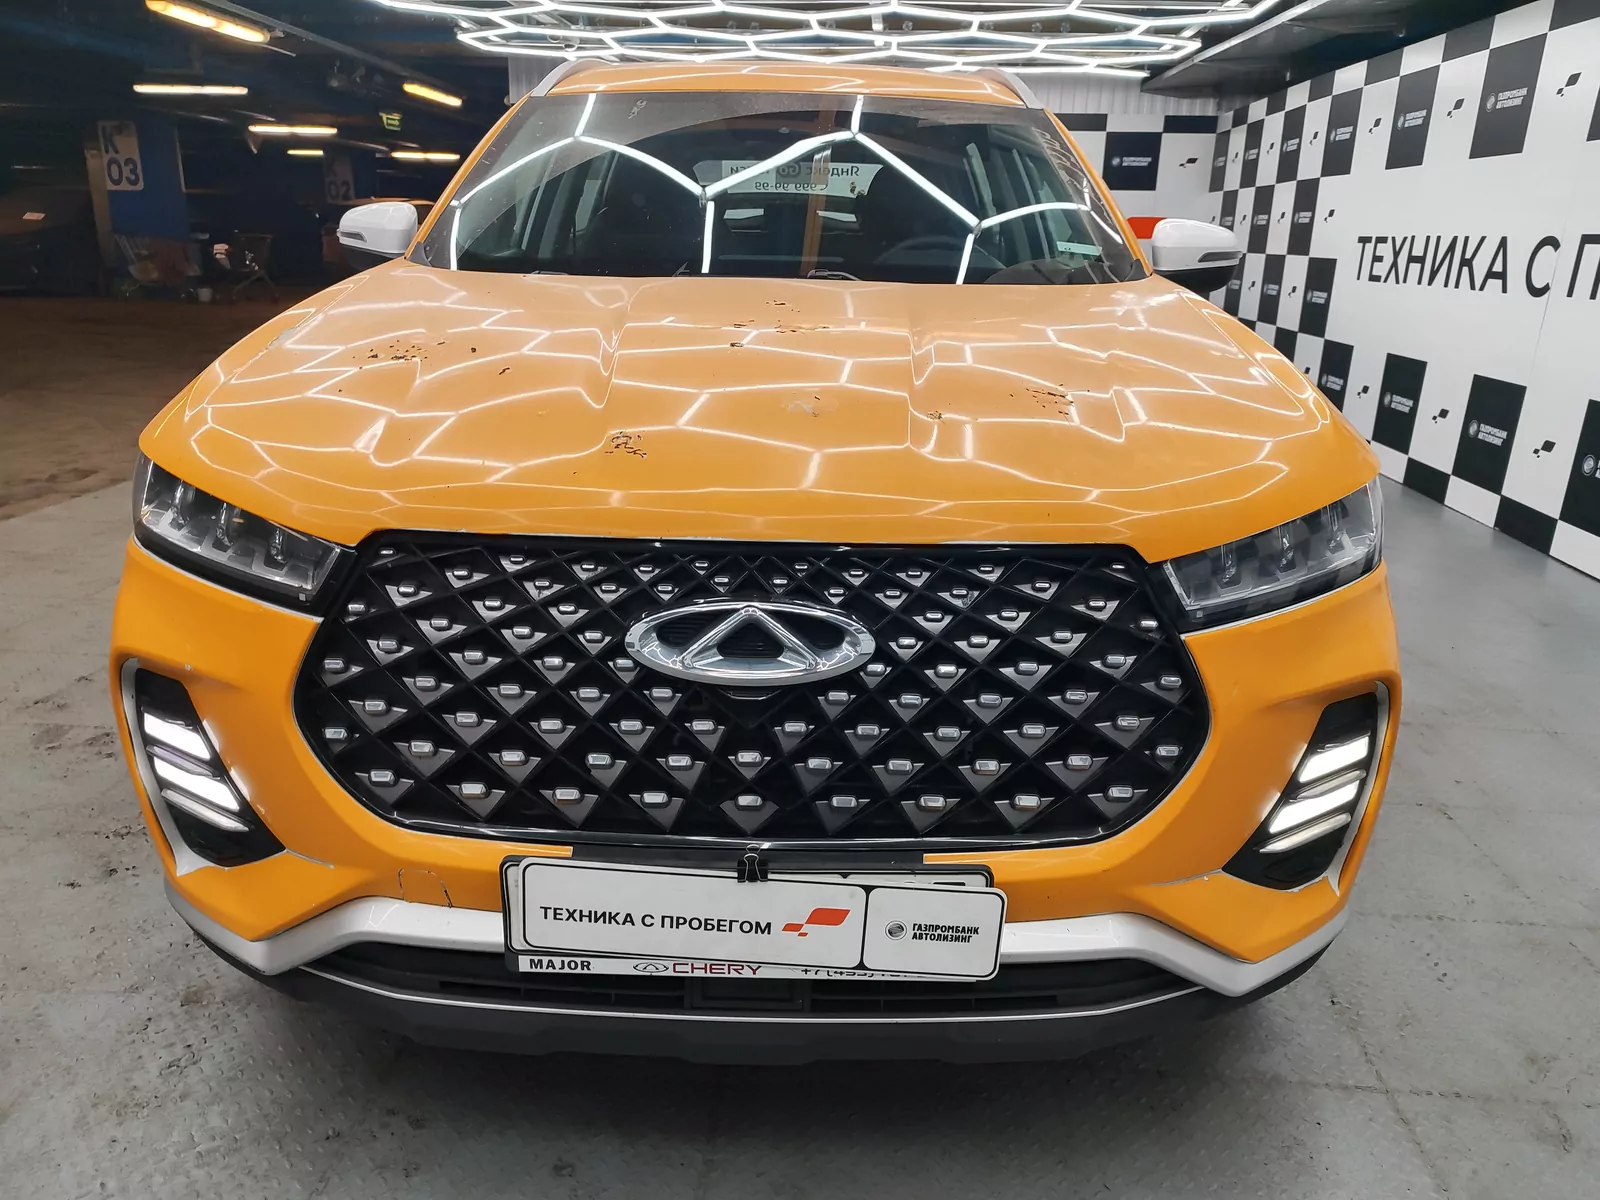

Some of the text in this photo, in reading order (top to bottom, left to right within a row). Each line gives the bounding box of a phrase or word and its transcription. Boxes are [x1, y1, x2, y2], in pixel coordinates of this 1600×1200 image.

[107, 157, 140, 186] 03
[1357, 235, 1508, 294] ТЕХНИКА
[1525, 235, 1561, 298] С
[540, 906, 772, 935] ТЕХНИКА С ПРОБЕГОМ
[912, 922, 980, 935] ГАЗПРОМБАНК
[911, 932, 973, 943] АВТОЛИЗИНГ
[529, 958, 592, 971] MAJOR
[672, 962, 763, 975] CHERY
